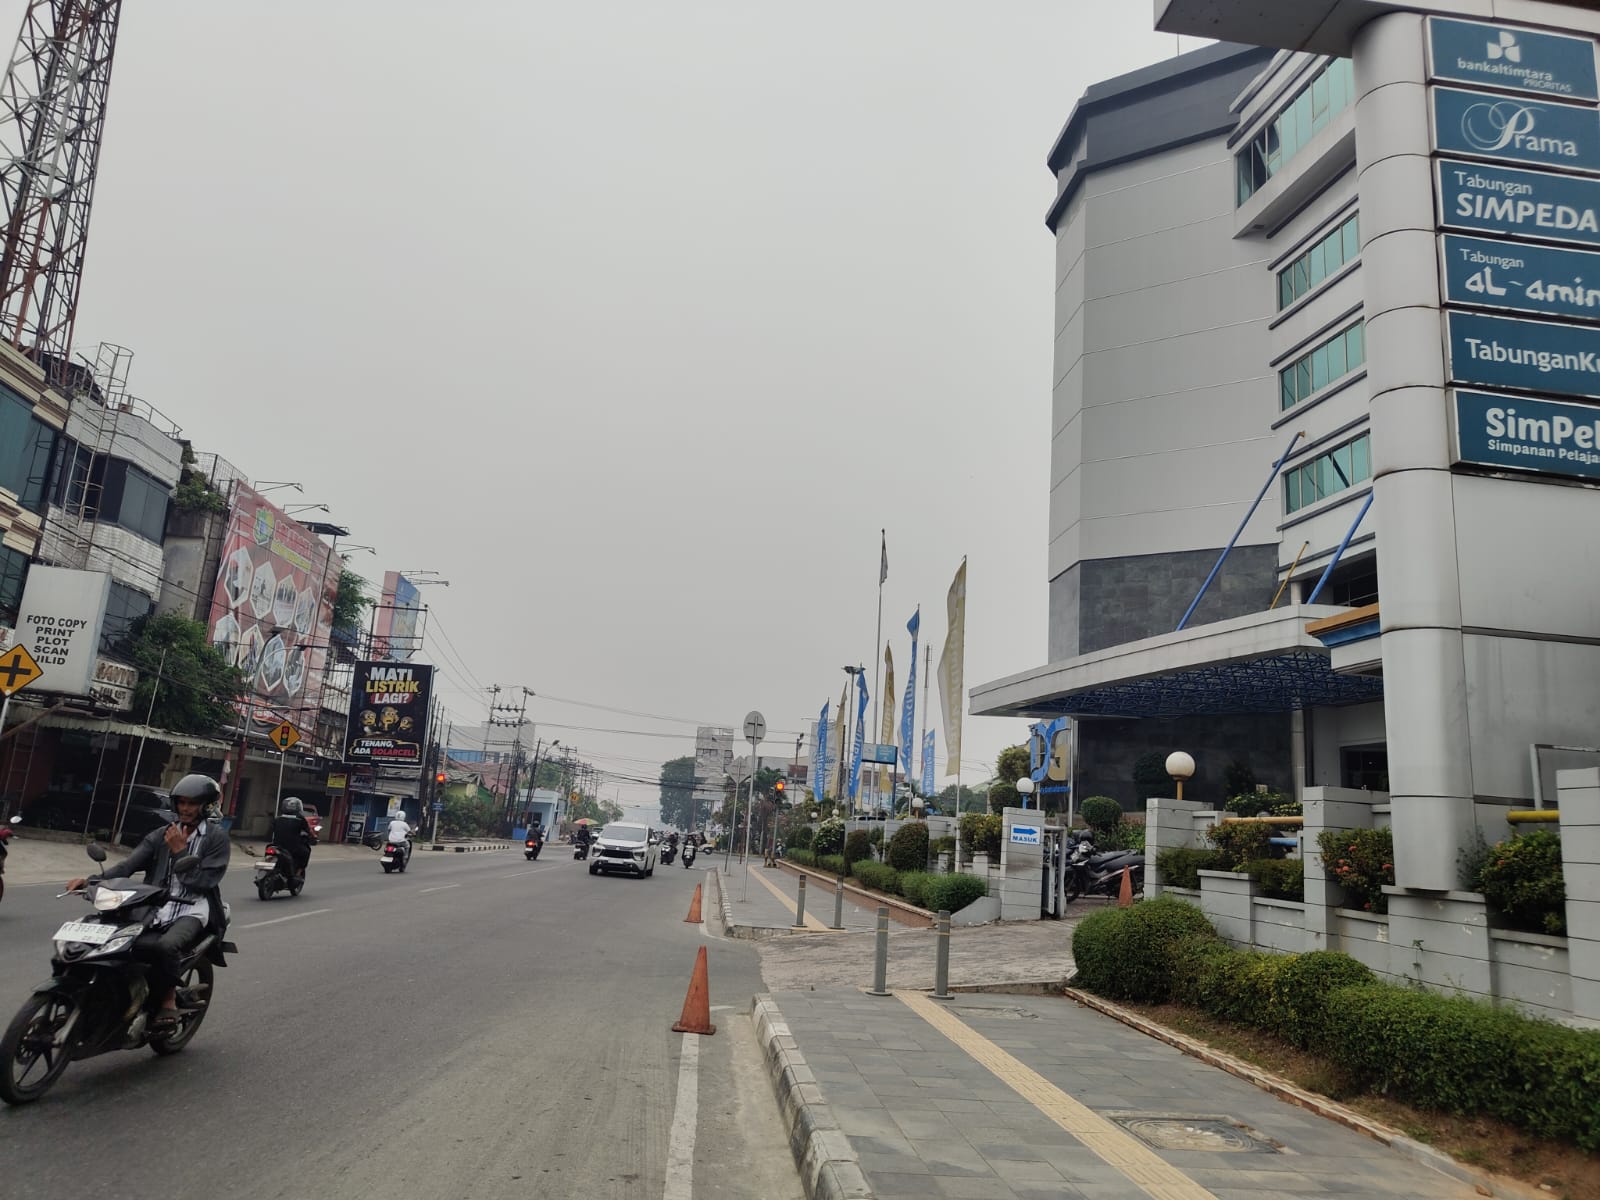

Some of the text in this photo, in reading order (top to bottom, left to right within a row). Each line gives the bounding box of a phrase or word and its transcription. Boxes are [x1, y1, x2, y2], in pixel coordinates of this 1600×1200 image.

[1457, 57, 1553, 81] bankaltimtara
[1523, 78, 1573, 93] PRIORITAS
[1461, 101, 1579, 157] Prama
[1454, 170, 1533, 196] Tabungan
[1456, 192, 1599, 233] SIMPEDA
[1459, 248, 1525, 270] Tabungan
[1464, 338, 1600, 373] TabunganK
[1487, 439, 1556, 458] Simpanan
[26, 614, 87, 629] FOTO COPY
[35, 626, 75, 638] PRINT
[36, 636, 70, 646] PLOT
[33, 645, 69, 656] SCAN
[35, 655, 66, 665] JILID
[370, 667, 413, 681] MATI
[365, 681, 419, 693] LISTRIK
[374, 692, 410, 704] LAGI?
[361, 740, 394, 748] TENANG,
[353, 747, 416, 757] ADA SOLARCELL
[1012, 835, 1038, 843] MASUK
